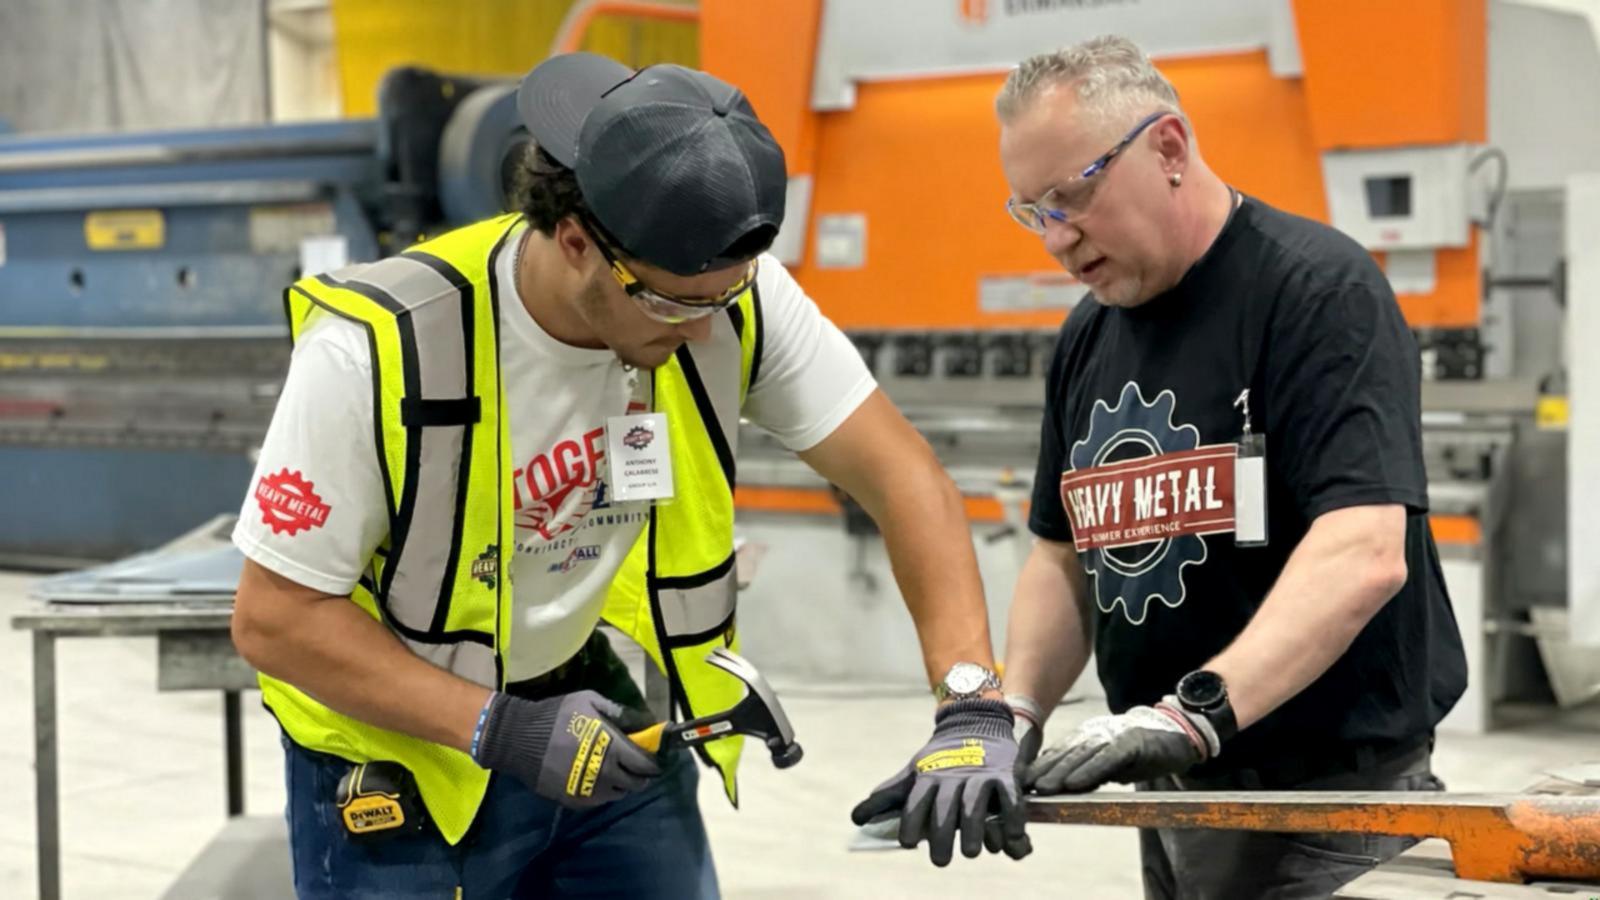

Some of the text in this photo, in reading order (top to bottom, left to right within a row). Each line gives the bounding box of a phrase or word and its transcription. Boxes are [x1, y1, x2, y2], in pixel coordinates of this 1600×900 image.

[513, 427, 606, 510] TOGE
[1133, 466, 1224, 521] METAL
[257, 482, 325, 522] HEAVY METAL
